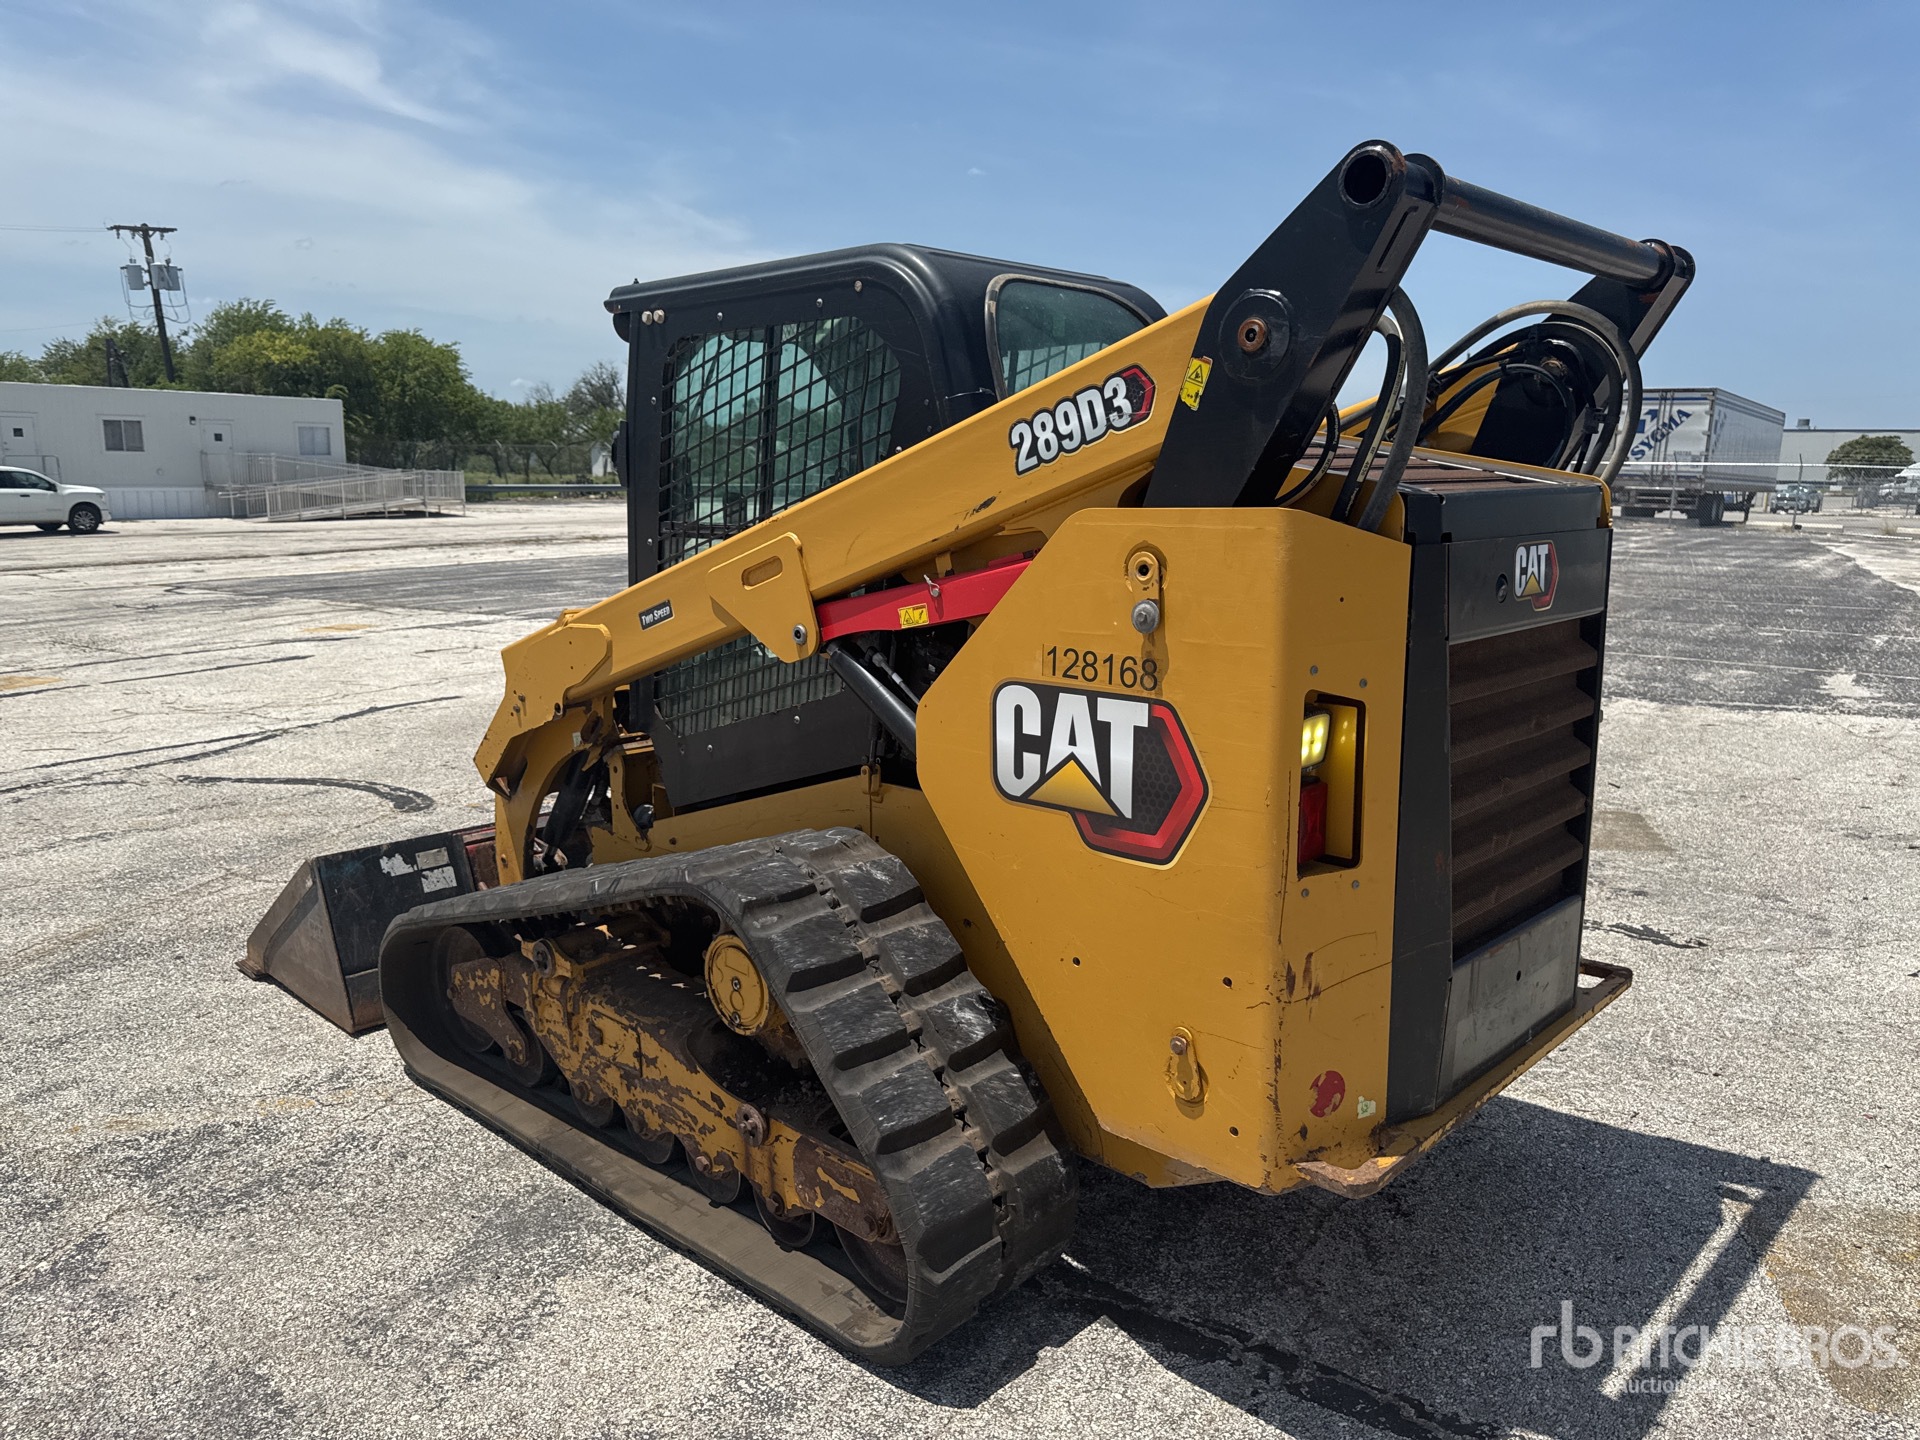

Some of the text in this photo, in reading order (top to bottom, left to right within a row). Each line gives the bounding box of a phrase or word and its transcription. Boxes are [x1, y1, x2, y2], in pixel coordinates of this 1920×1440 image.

[1011, 376, 1133, 472] 289D3
[1630, 408, 1693, 461] SYGMA
[1514, 543, 1549, 597] CAT
[1046, 645, 1158, 692] 128168
[995, 684, 1149, 819] CAT
